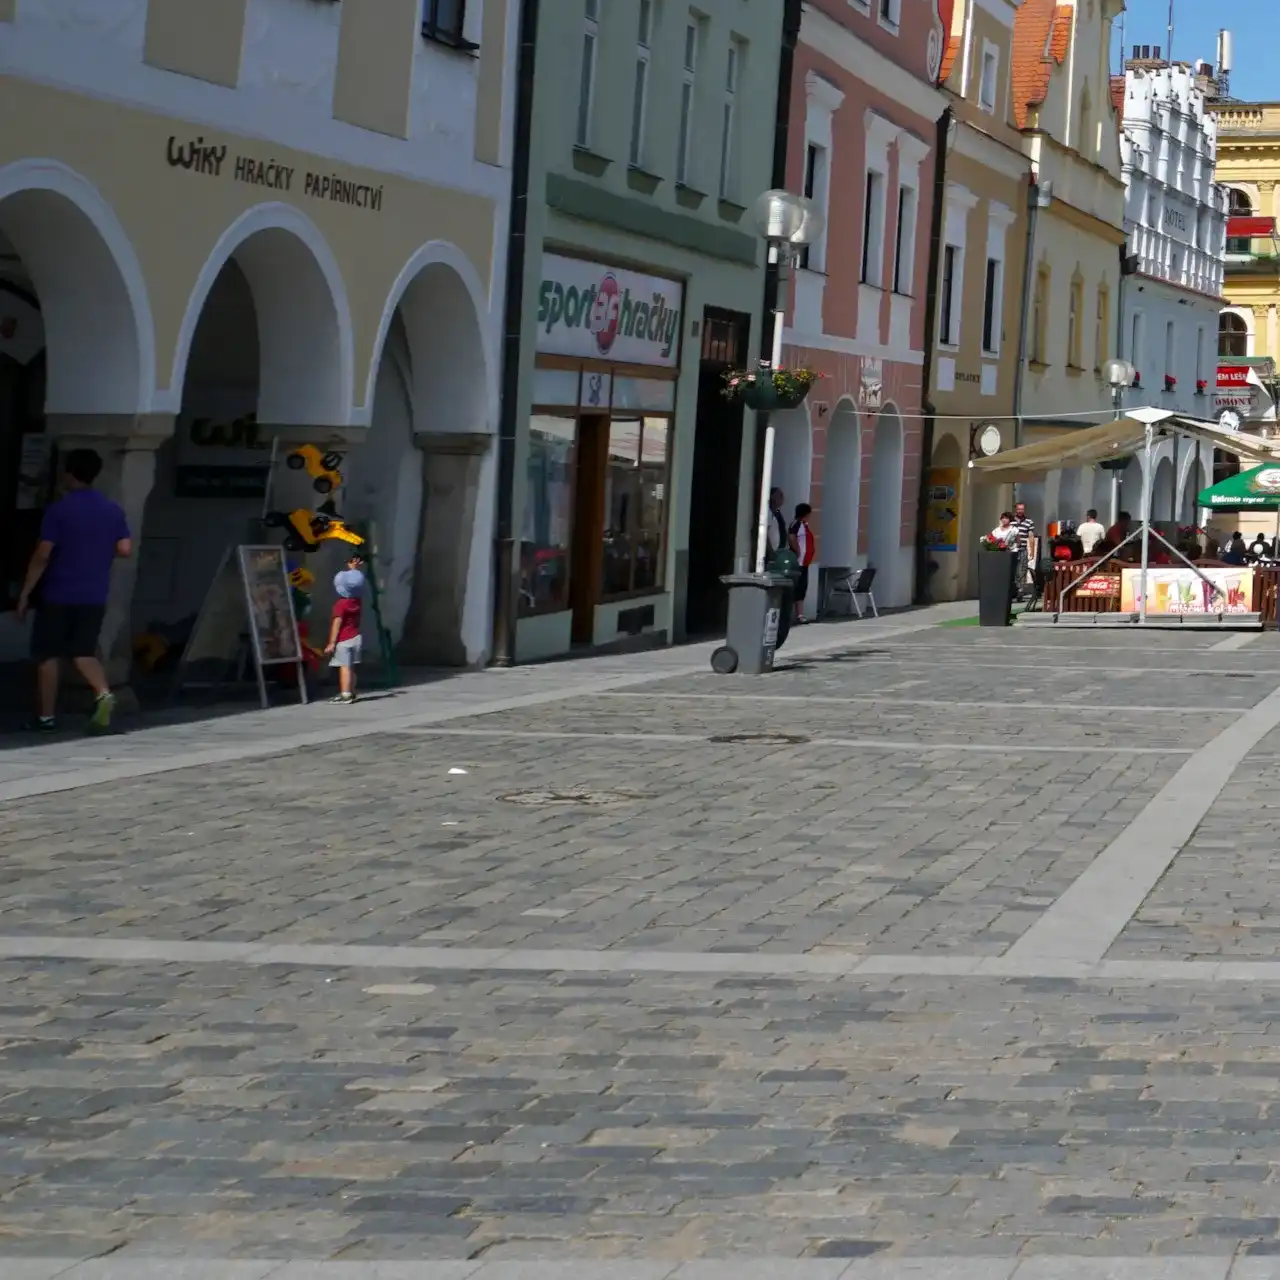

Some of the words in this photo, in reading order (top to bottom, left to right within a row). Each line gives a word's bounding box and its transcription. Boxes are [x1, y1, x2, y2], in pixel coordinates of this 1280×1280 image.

[234, 156, 294, 191] HRAČKY
[304, 173, 384, 211] PAPÍRNICTVÍ
[537, 280, 596, 334] sport
[616, 287, 679, 358] hračky
